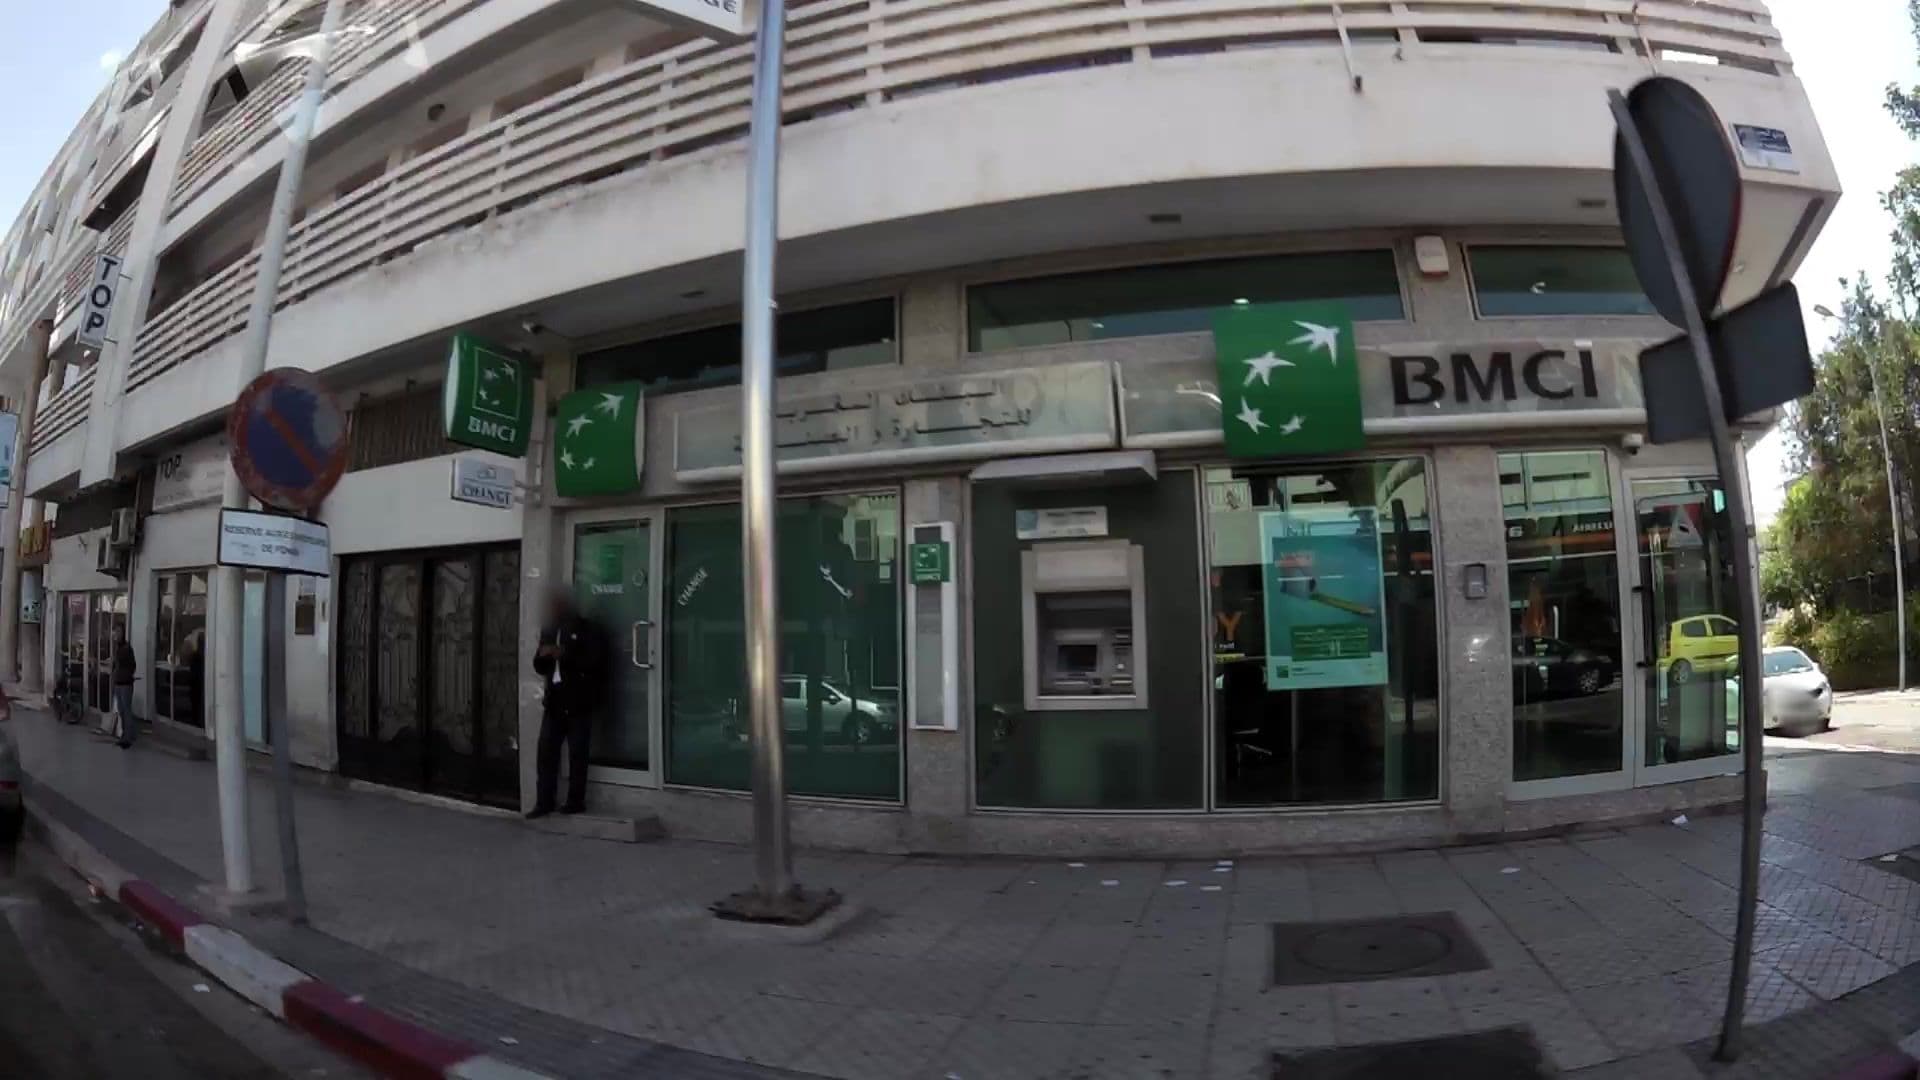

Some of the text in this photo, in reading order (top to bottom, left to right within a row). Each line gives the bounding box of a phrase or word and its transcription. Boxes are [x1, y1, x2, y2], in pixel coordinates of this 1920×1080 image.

[85, 257, 118, 333] TOP
[1389, 350, 1599, 406] BMCI
[468, 415, 516, 443] BMCI
